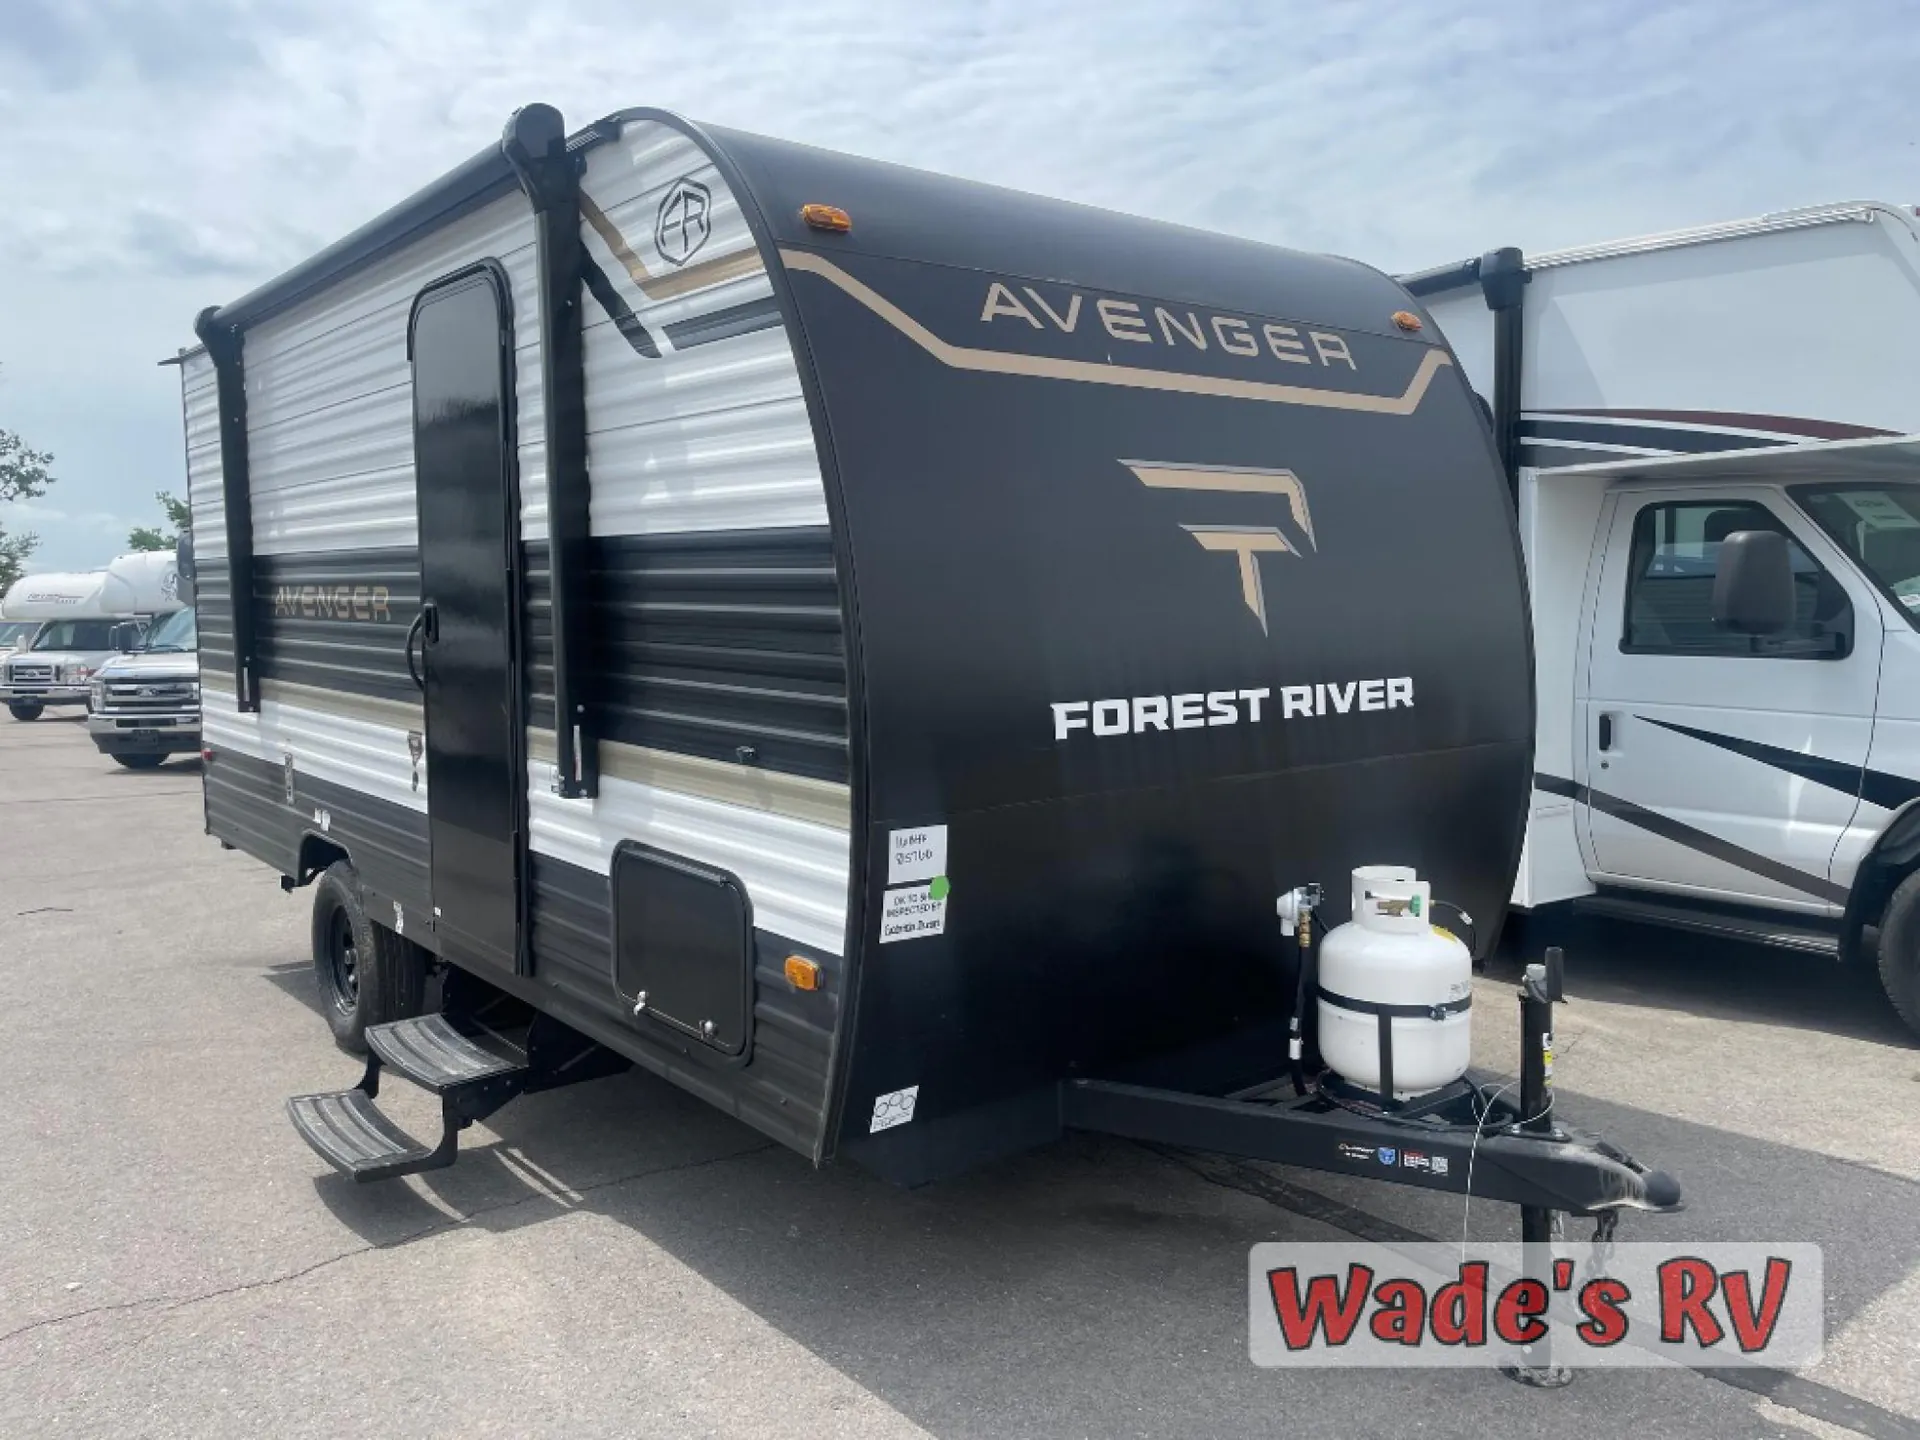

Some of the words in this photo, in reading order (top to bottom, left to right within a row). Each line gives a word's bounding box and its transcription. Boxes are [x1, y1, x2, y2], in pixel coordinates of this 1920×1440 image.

[980, 282, 1358, 371] AVENGER
[274, 585, 391, 621] AVENGER
[1050, 687, 1270, 740] FOREST
[1280, 676, 1415, 719] RIVER
